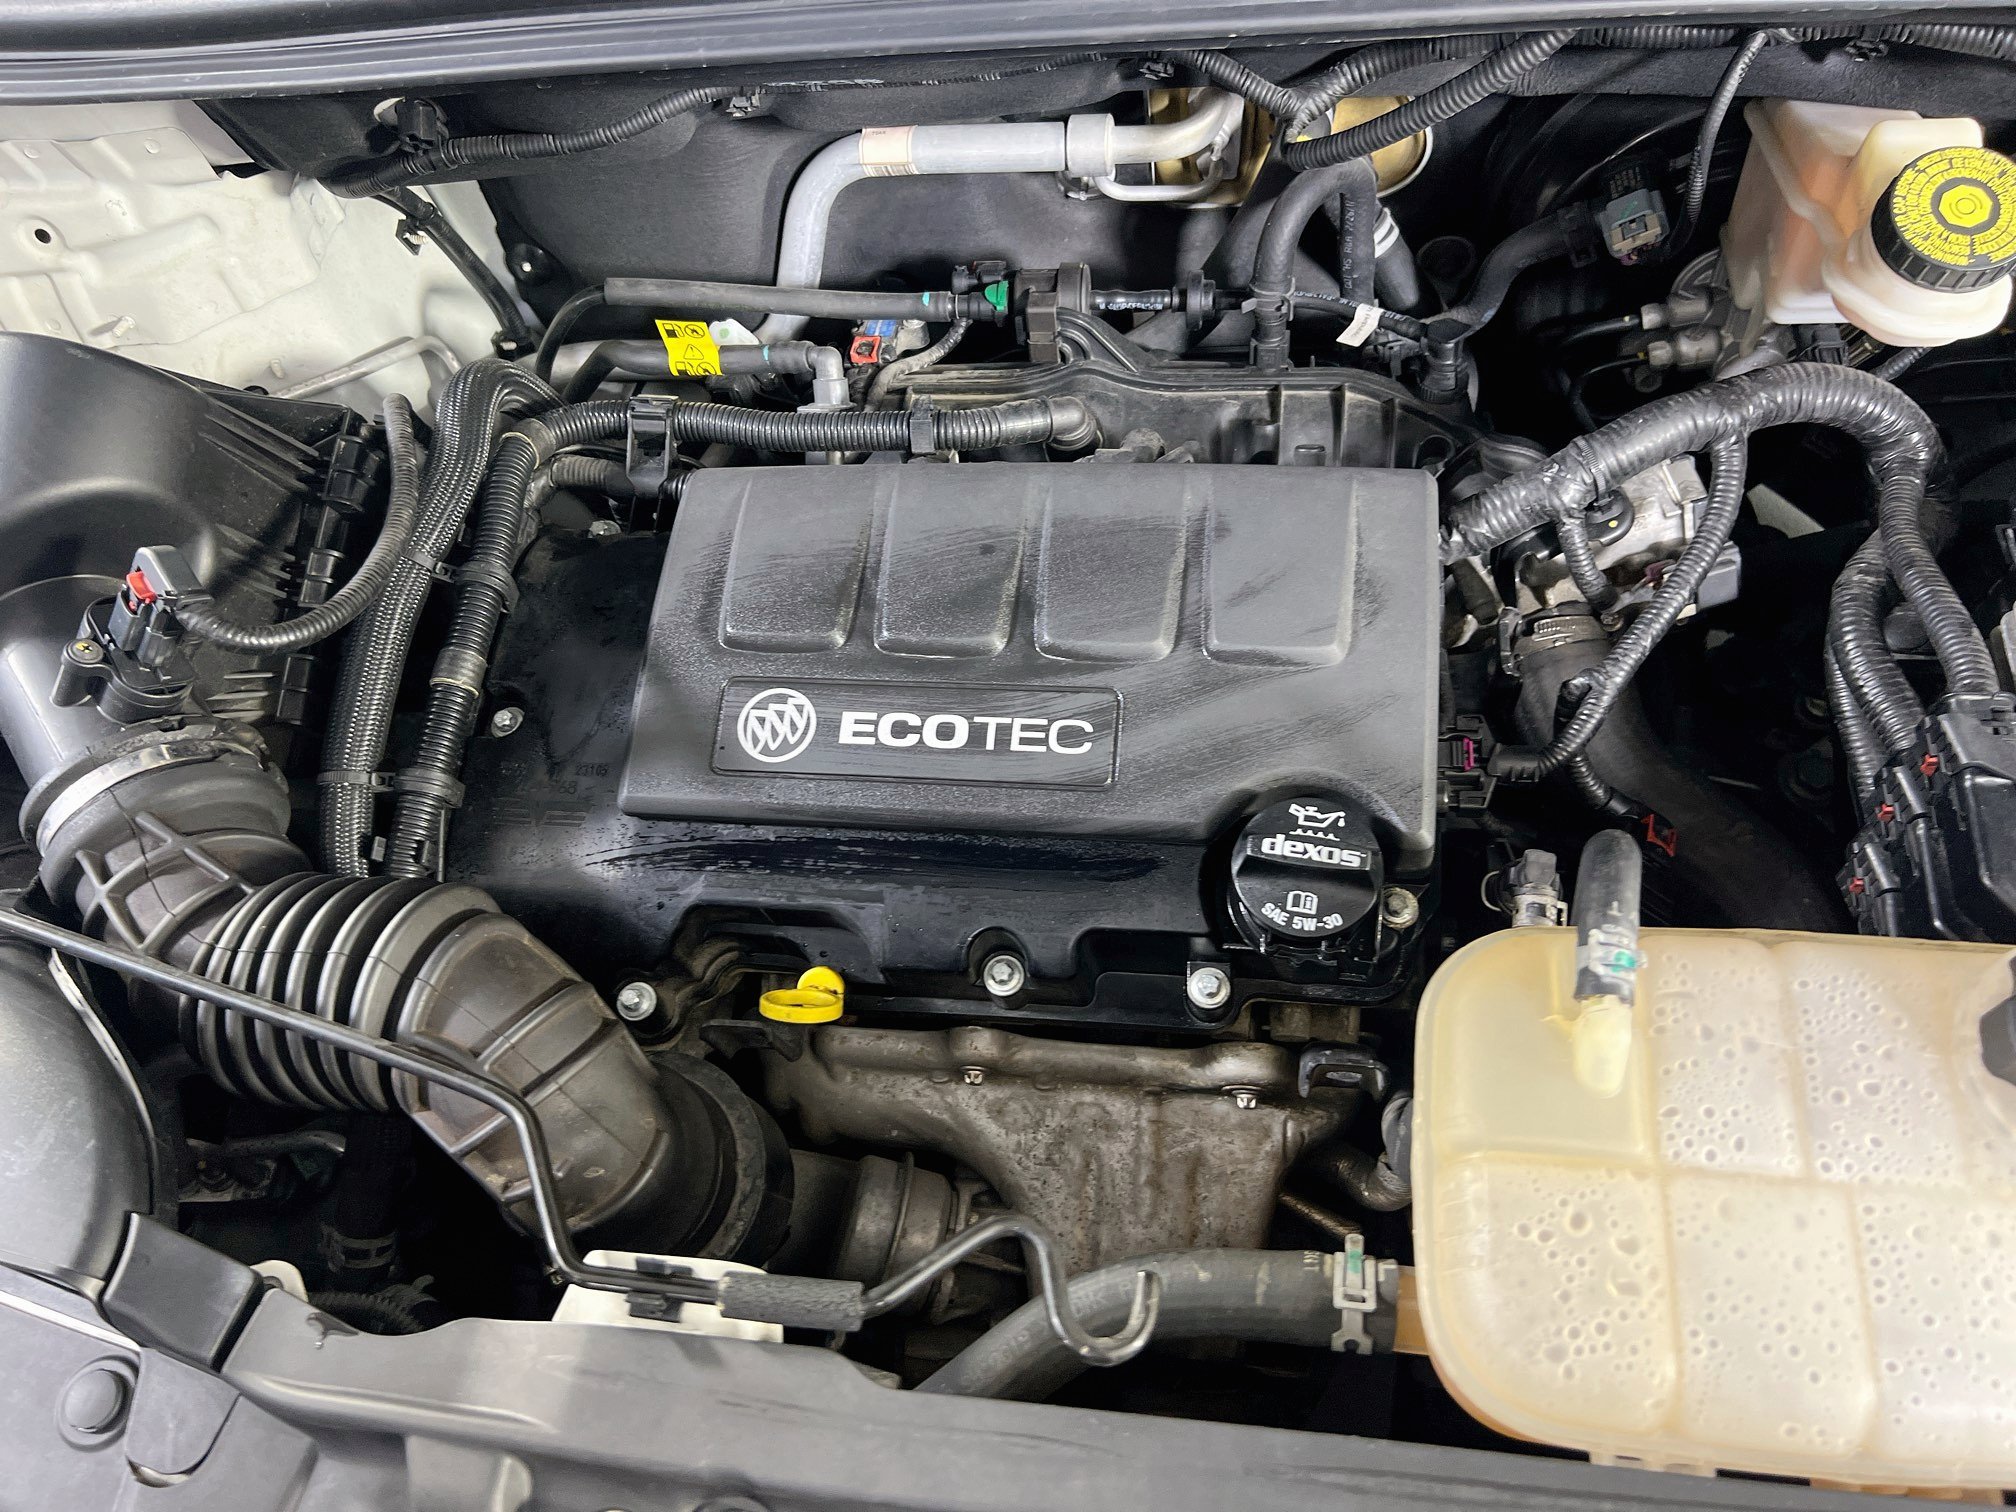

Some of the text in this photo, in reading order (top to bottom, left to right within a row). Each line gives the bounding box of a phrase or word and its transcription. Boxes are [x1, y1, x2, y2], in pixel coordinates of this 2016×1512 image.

[1893, 196, 1906, 214] CAP
[838, 711, 1093, 755] ECOTEC
[1261, 834, 1362, 868] dexos
[1261, 903, 1344, 931] SAE 5W-30
